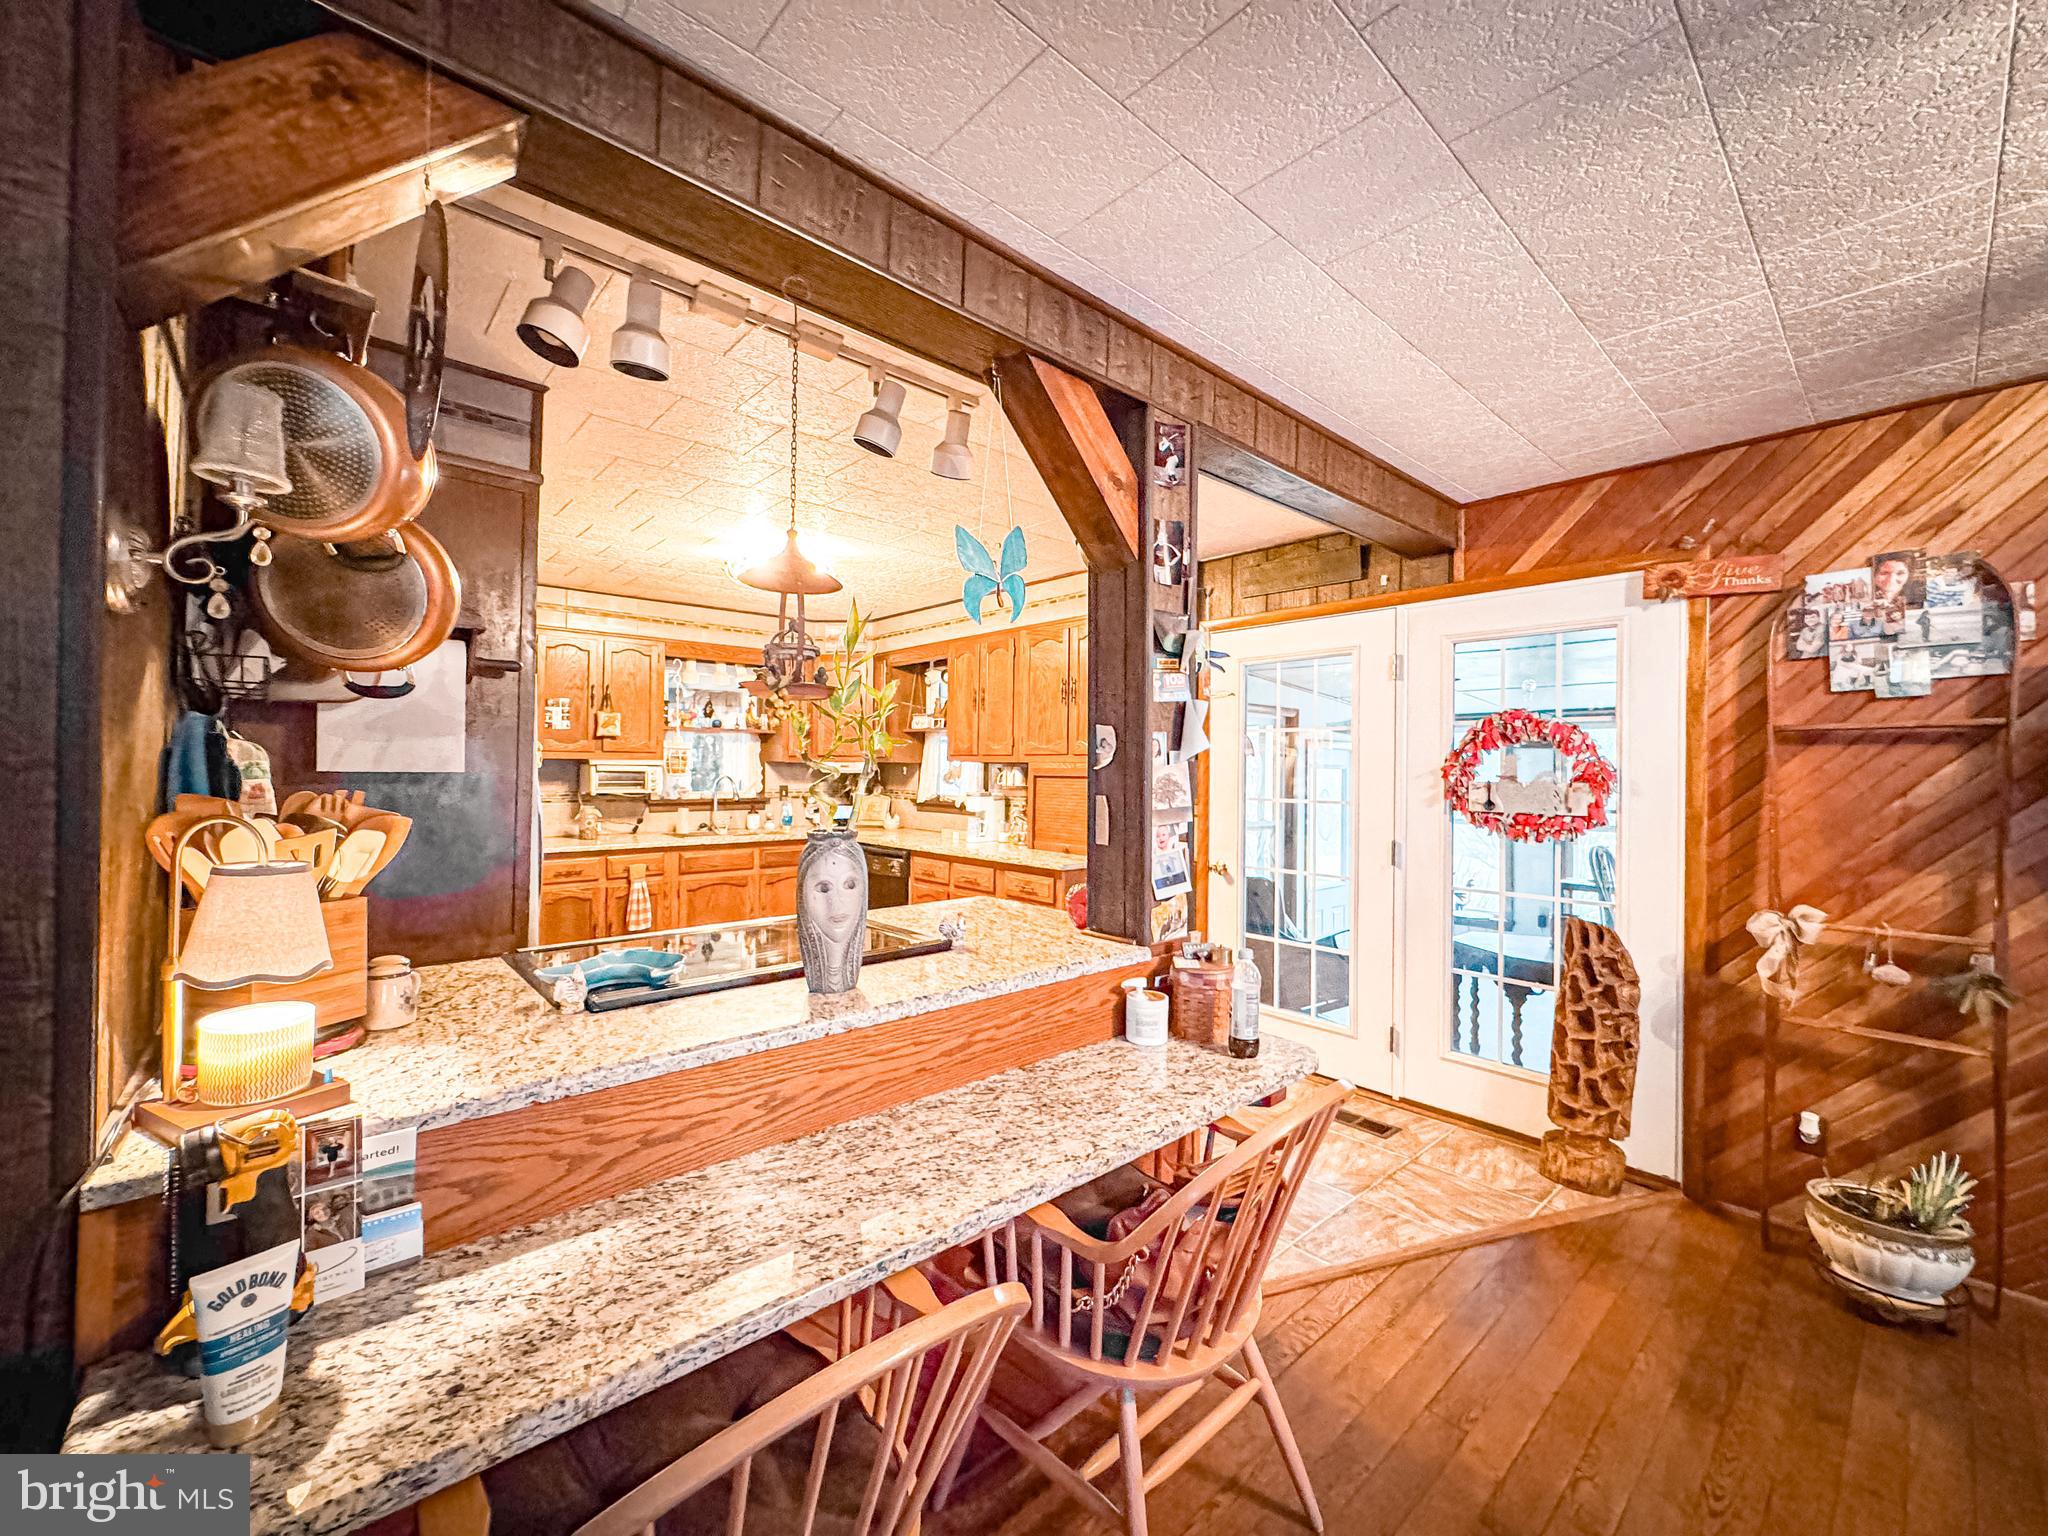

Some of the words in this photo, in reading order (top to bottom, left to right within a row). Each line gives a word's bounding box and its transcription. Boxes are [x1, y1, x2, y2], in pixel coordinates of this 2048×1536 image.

[1698, 561, 1761, 592] Give
[1722, 575, 1772, 586] Thanks
[207, 1279, 247, 1312] GOLD
[248, 1271, 287, 1290] BOND
